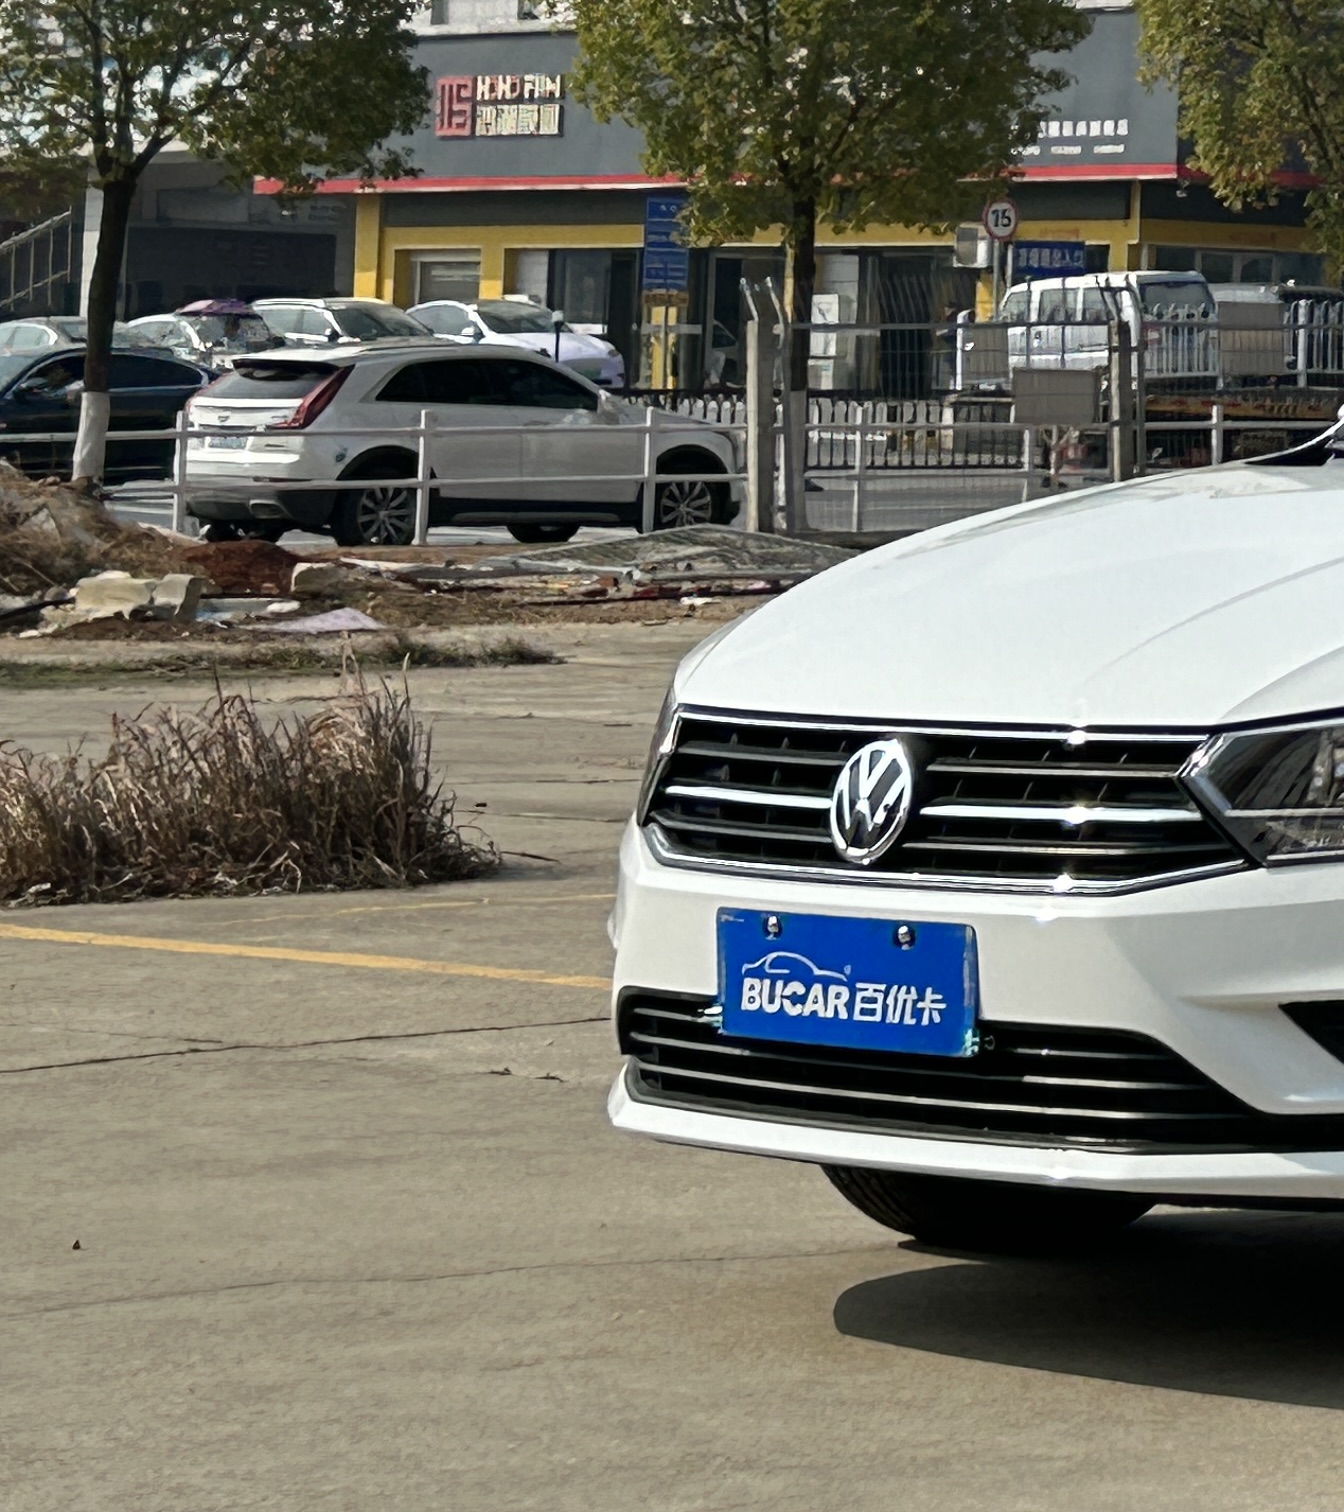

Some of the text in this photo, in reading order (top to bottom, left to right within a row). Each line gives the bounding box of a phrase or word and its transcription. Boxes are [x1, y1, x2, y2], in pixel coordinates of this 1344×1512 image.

[741, 977, 947, 1027] BUCAR 百优卡
